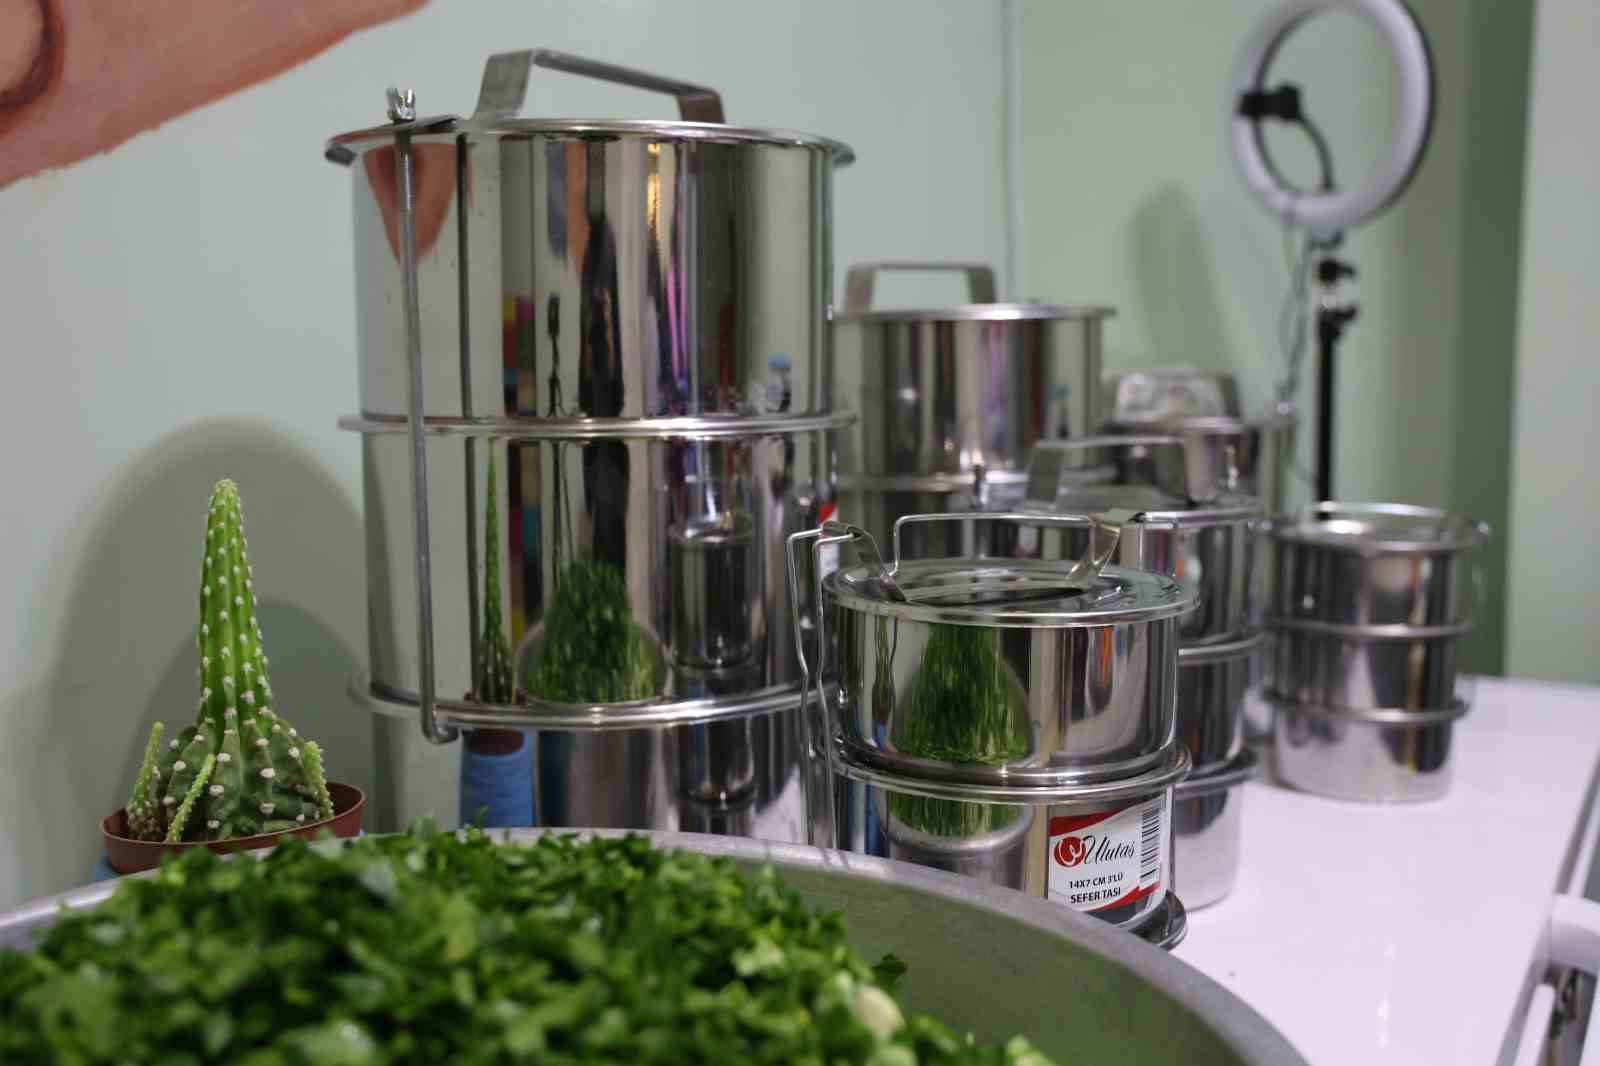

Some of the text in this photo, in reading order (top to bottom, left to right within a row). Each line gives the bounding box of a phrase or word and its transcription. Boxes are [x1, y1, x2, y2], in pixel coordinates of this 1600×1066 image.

[1069, 879, 1091, 889] 14X7
[1092, 876, 1106, 887] CM
[1070, 887, 1121, 904] SEFER TASI
